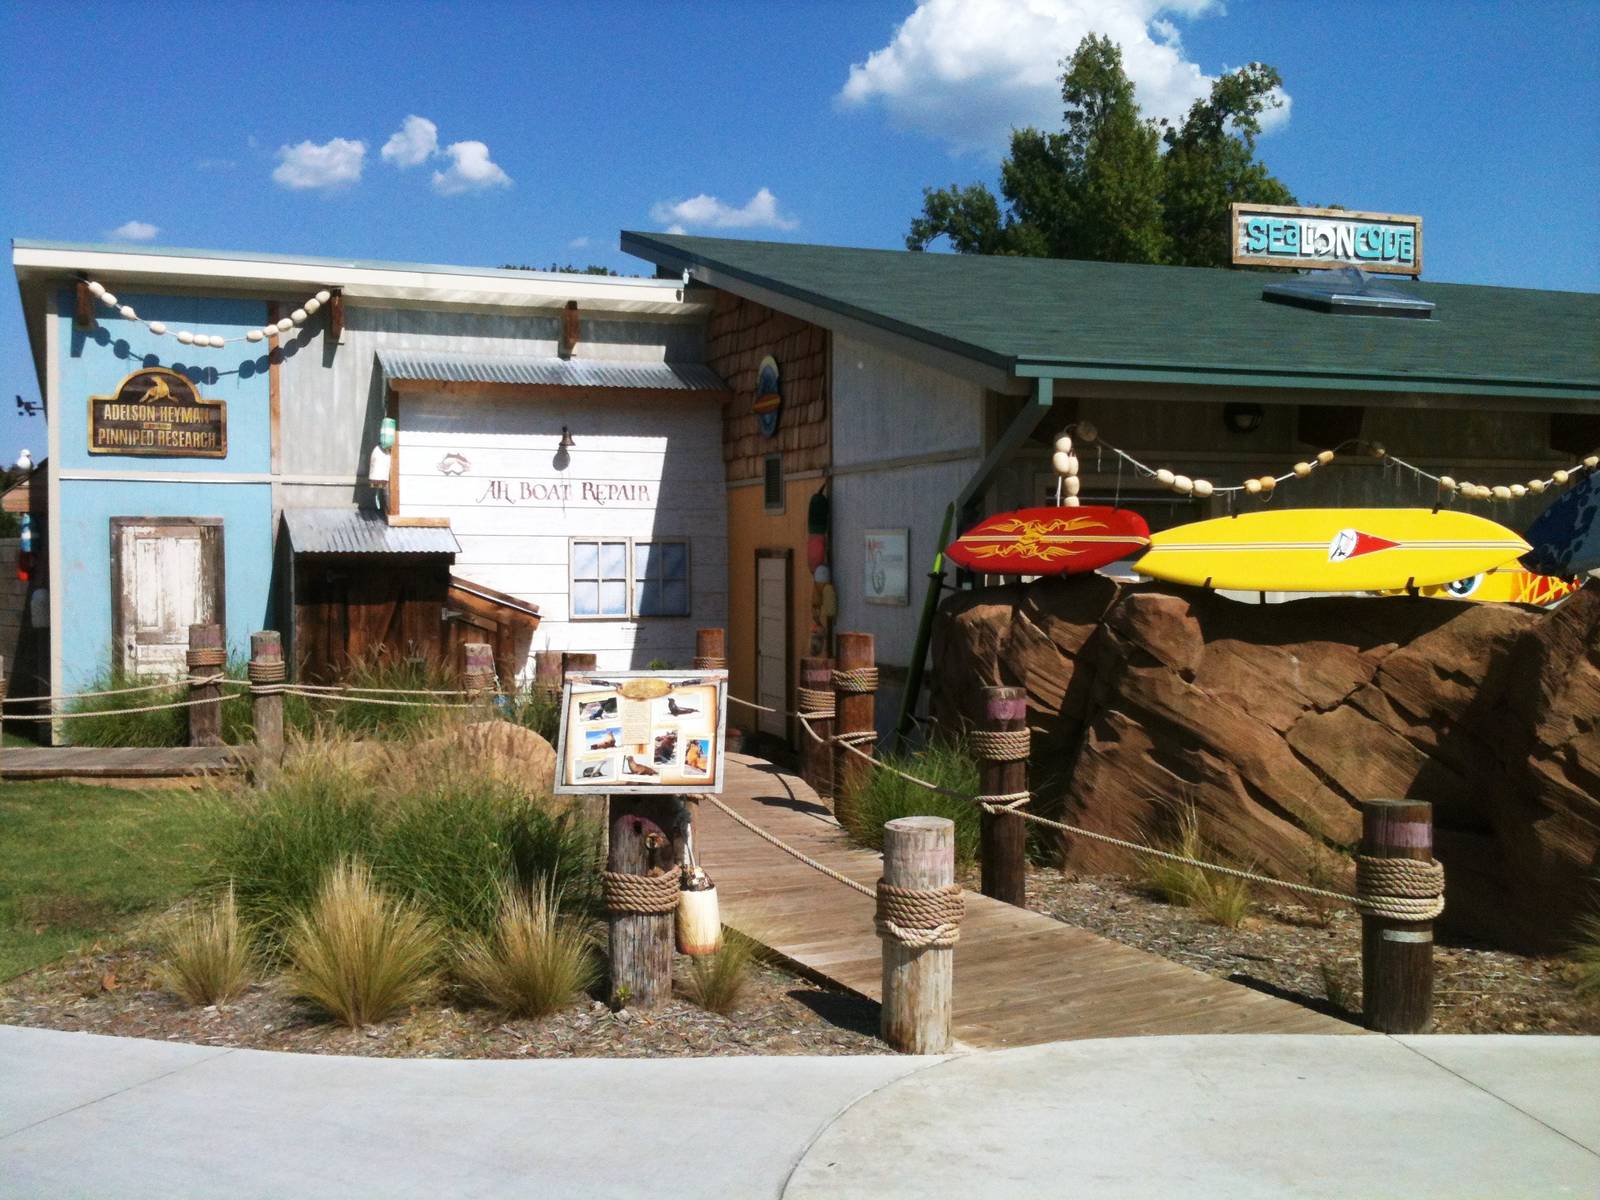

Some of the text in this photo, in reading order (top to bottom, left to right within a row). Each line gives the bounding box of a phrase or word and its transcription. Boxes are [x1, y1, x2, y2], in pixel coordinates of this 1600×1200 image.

[104, 404, 210, 424] ADELSON HEYMAN
[98, 428, 217, 448] PINNIPED RESEARCH
